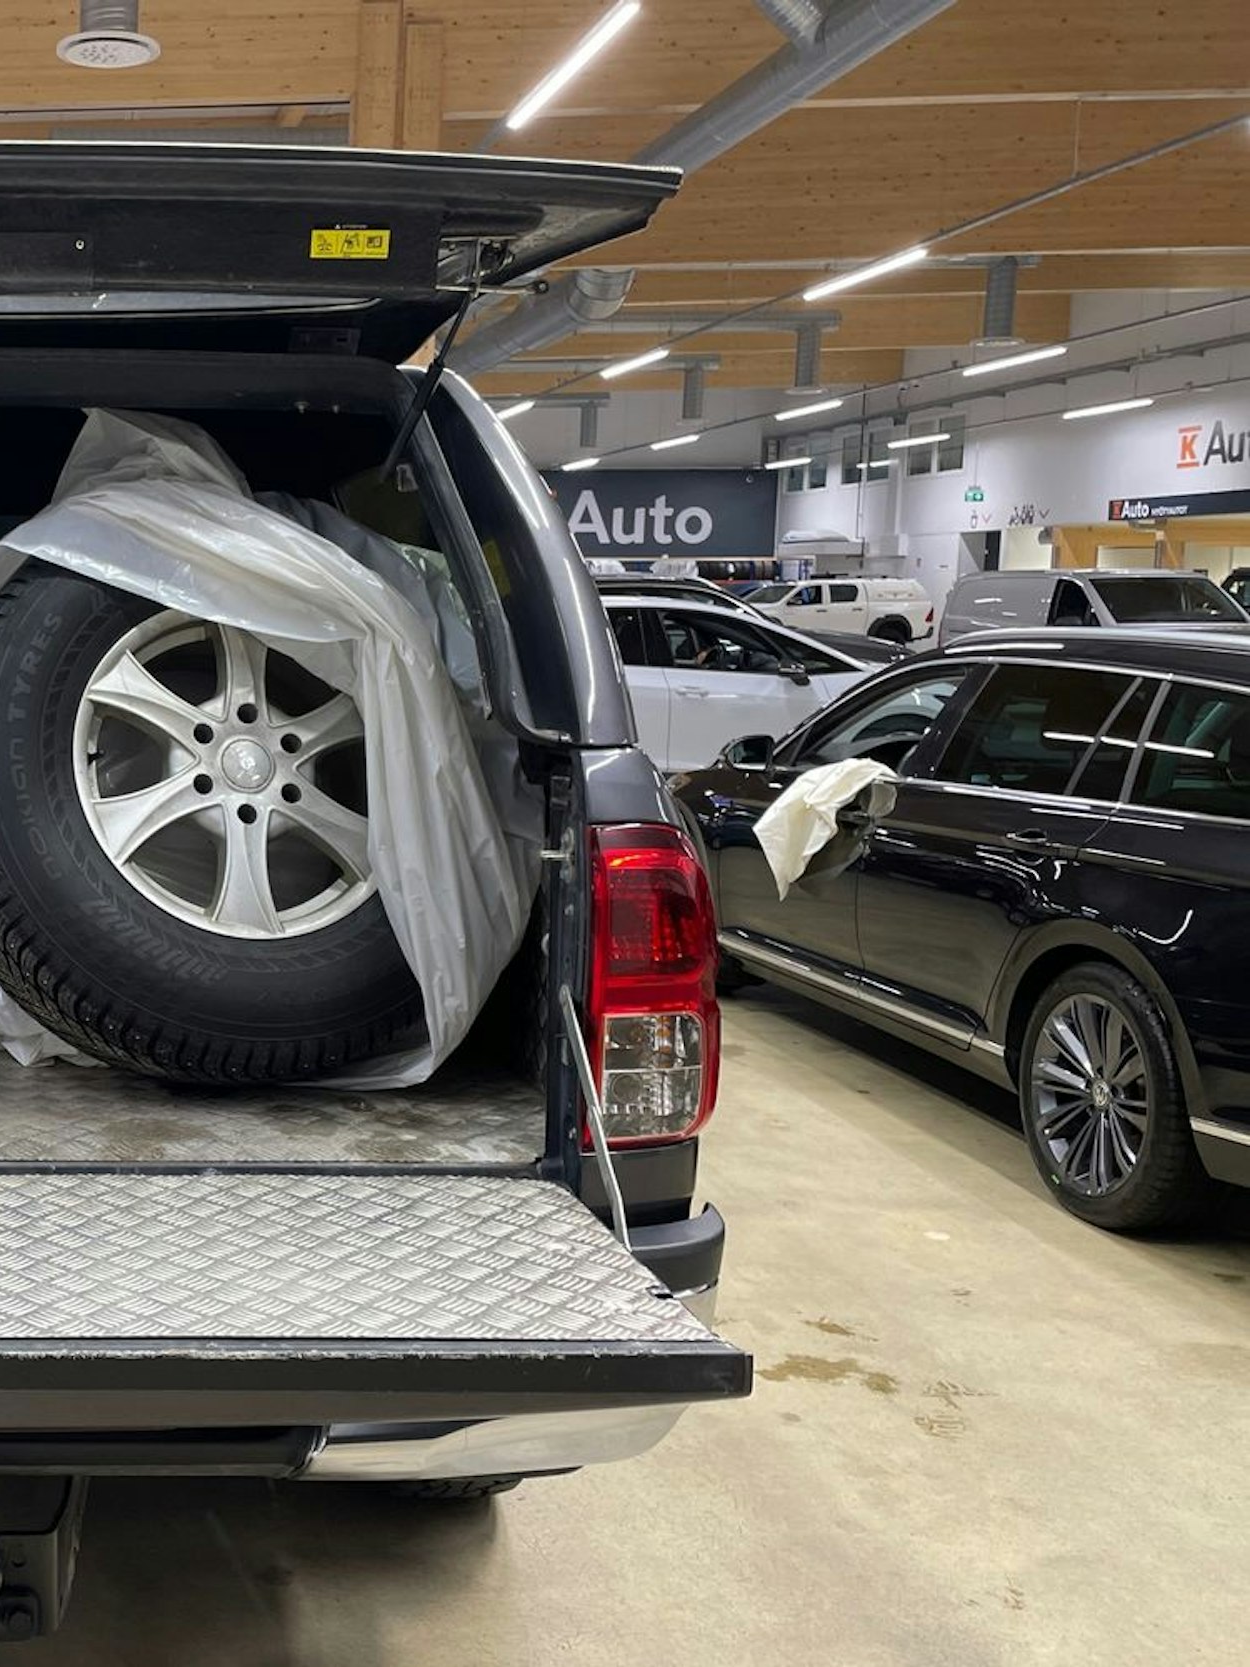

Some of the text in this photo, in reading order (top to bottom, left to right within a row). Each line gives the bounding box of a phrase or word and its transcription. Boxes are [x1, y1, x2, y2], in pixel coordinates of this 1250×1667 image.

[1180, 420, 1250, 465] K Au
[568, 489, 713, 545] Auto
[1121, 500, 1150, 519] Auto
[6, 611, 63, 723] TYRES
